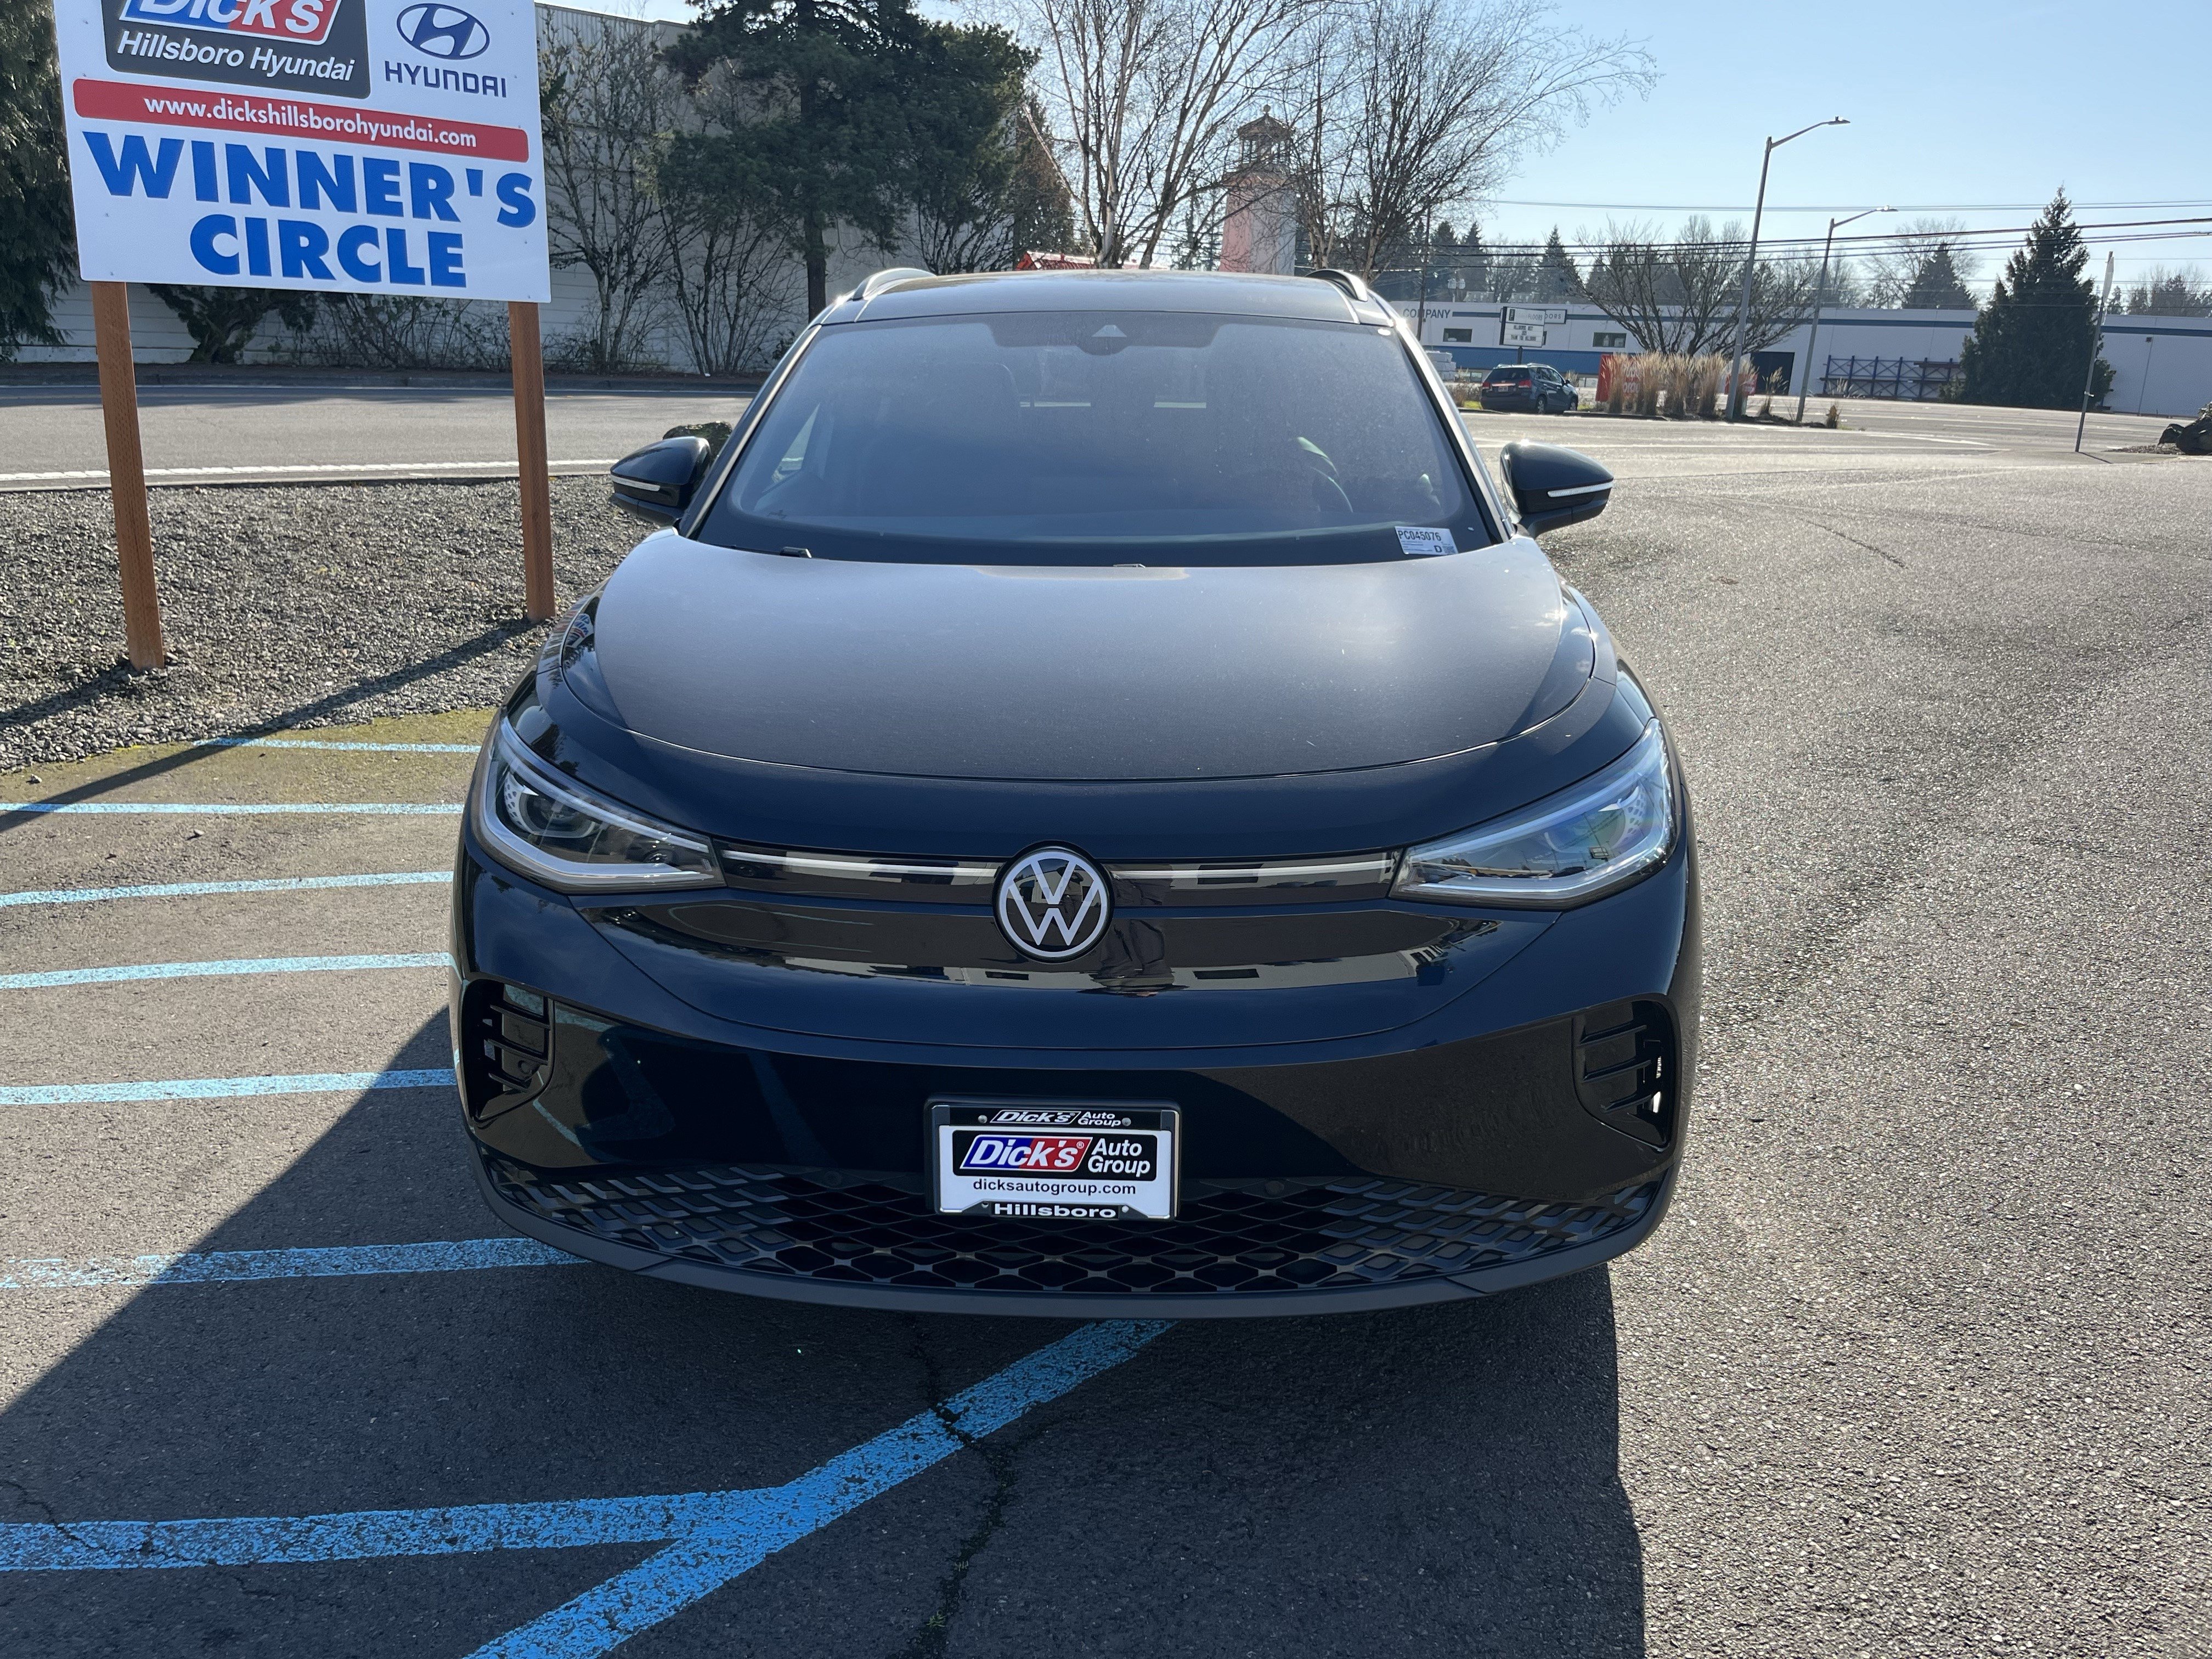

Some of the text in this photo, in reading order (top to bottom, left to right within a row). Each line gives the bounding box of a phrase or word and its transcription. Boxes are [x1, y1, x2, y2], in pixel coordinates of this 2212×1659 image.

[117, 30, 356, 81] Hillsboro Hyundai
[385, 60, 507, 98] HYUNDAI
[144, 97, 477, 149] www.dickshillsborohyundai.com
[82, 131, 536, 228] WINNER'S
[190, 214, 467, 288] CIRCLE
[1397, 530, 1442, 541] PC045076
[1077, 1118, 1121, 1127] Group
[969, 1139, 1077, 1167] Dick's
[1091, 1138, 1143, 1157] Auto
[1087, 1156, 1151, 1178] Group
[973, 1178, 1136, 1195] dicksautogroup.com
[994, 1203, 1117, 1218] Hillsboro
